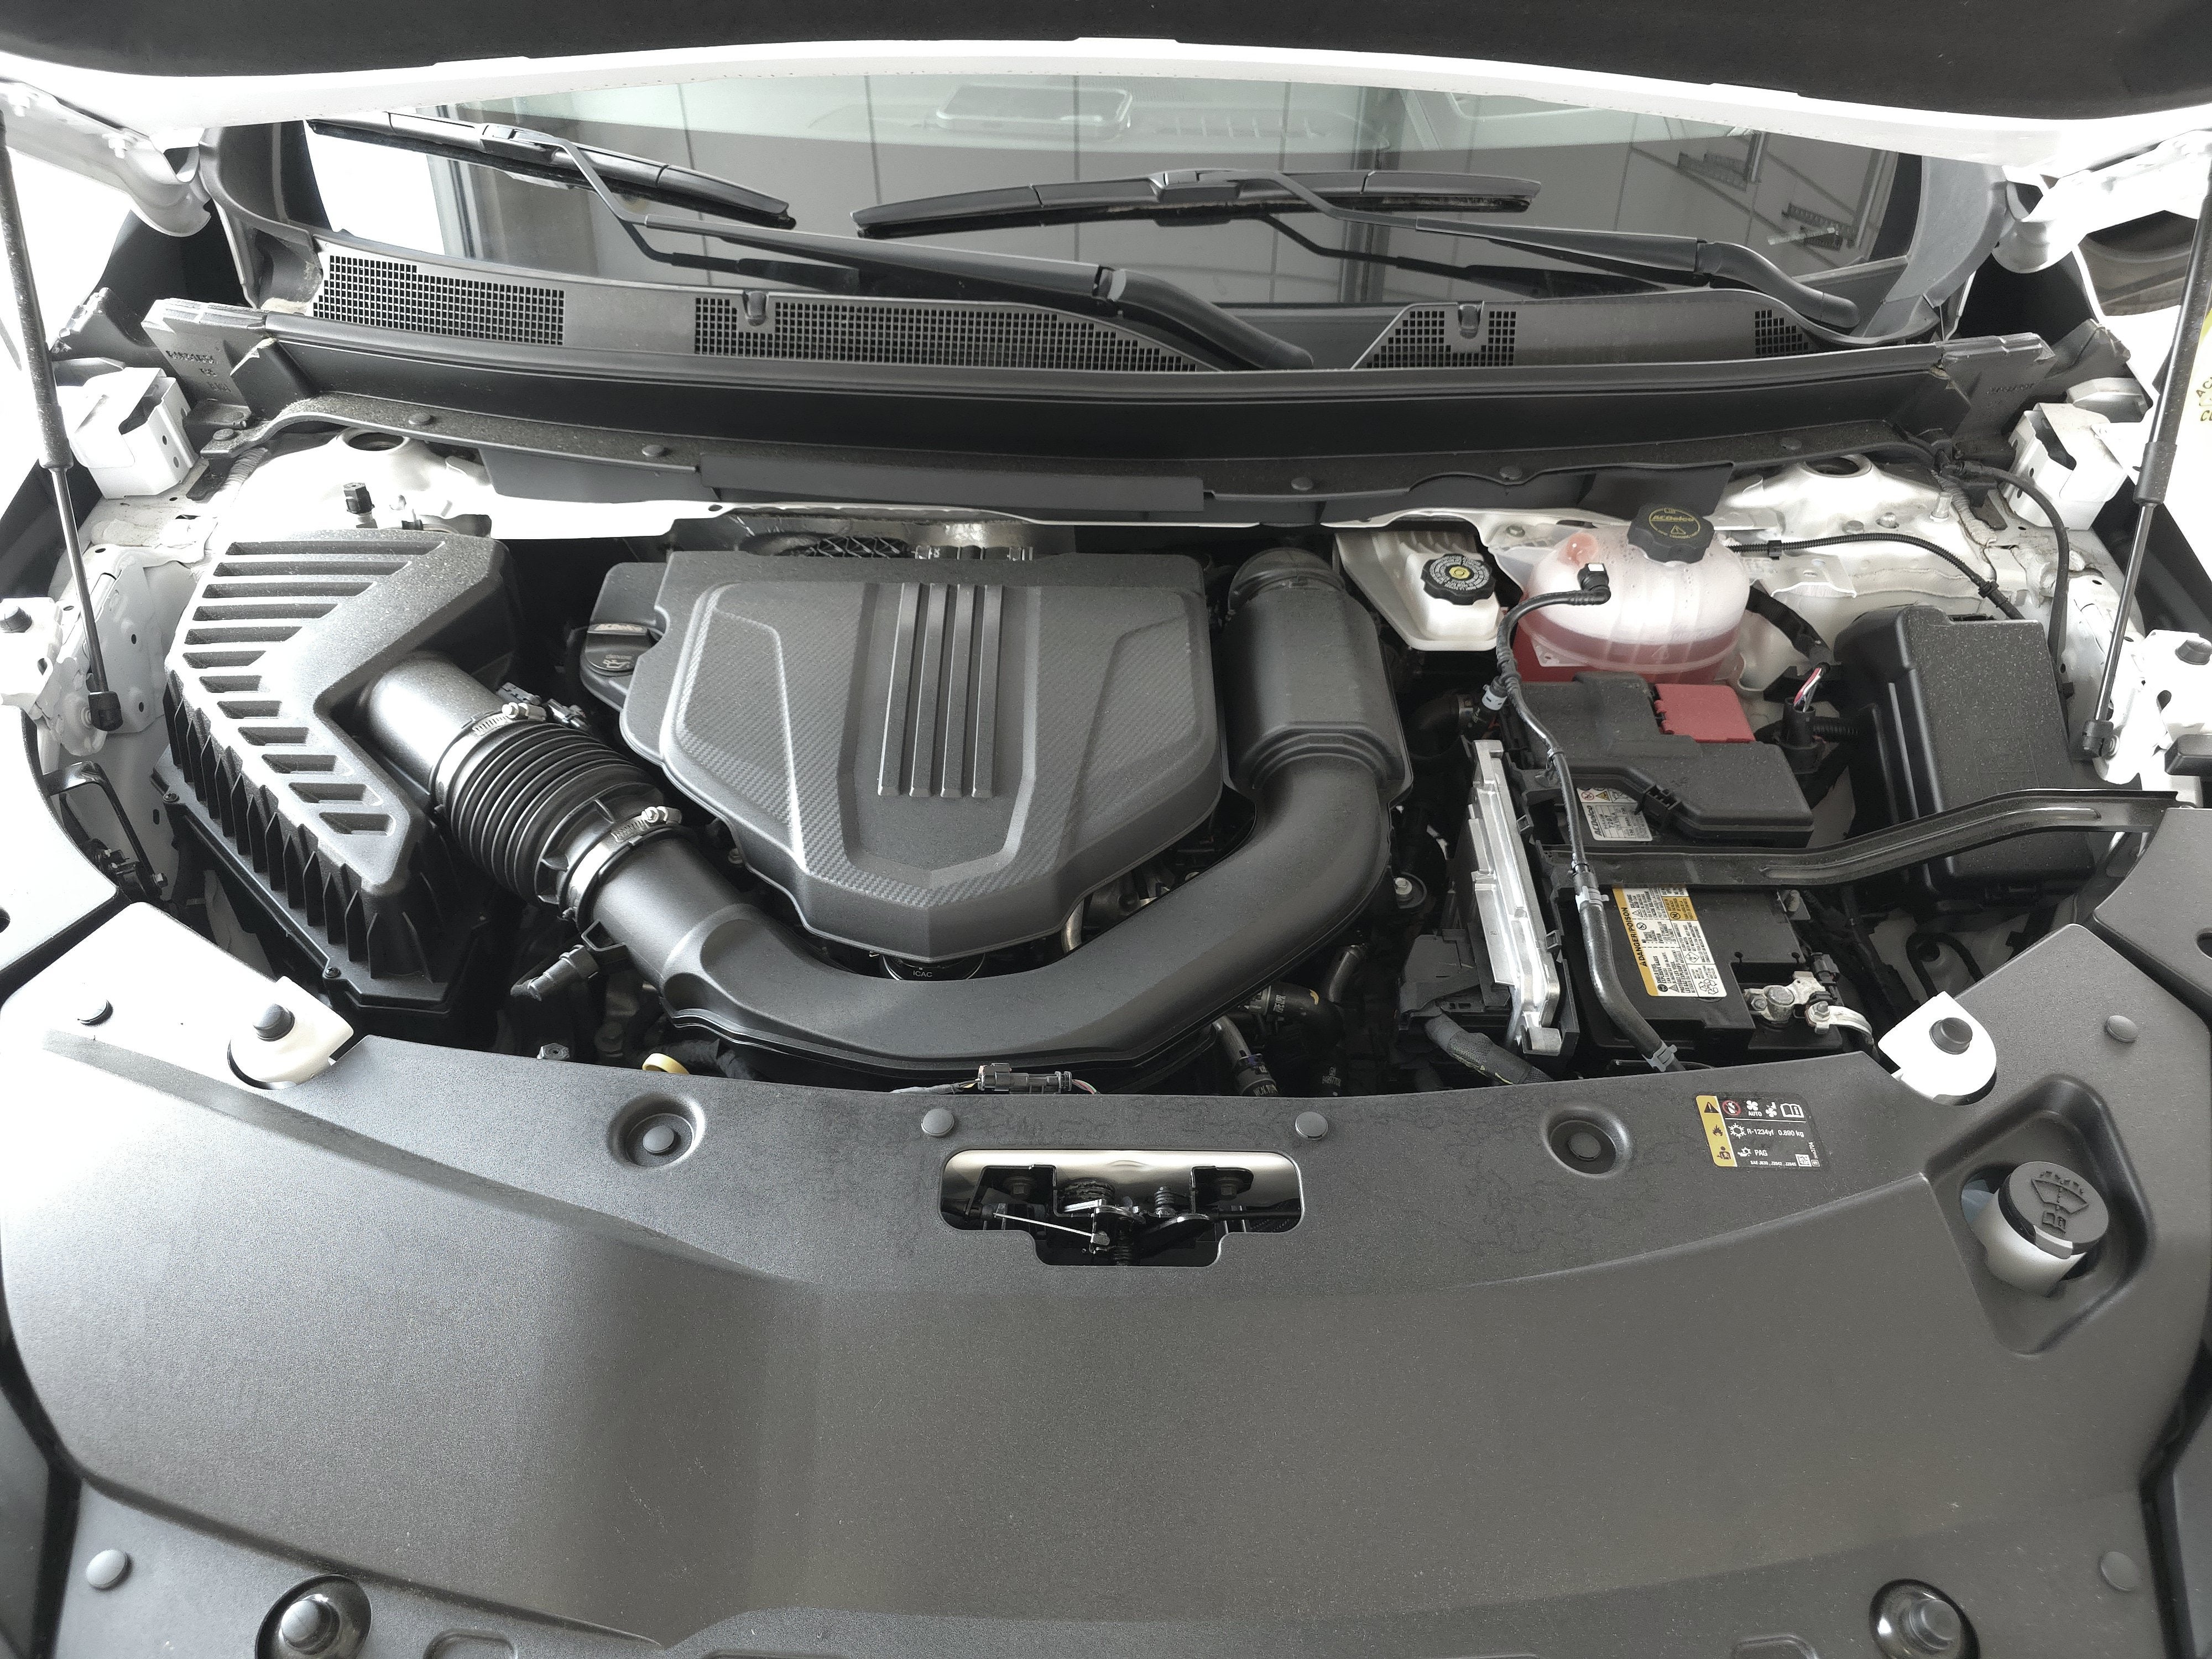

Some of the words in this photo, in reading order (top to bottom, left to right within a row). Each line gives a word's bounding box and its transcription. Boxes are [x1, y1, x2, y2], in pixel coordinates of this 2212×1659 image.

[1587, 805, 1602, 836] ACDelco
[1621, 907, 1644, 961] DANGER/POISON
[1746, 1128, 1774, 1136] R-1234yf
